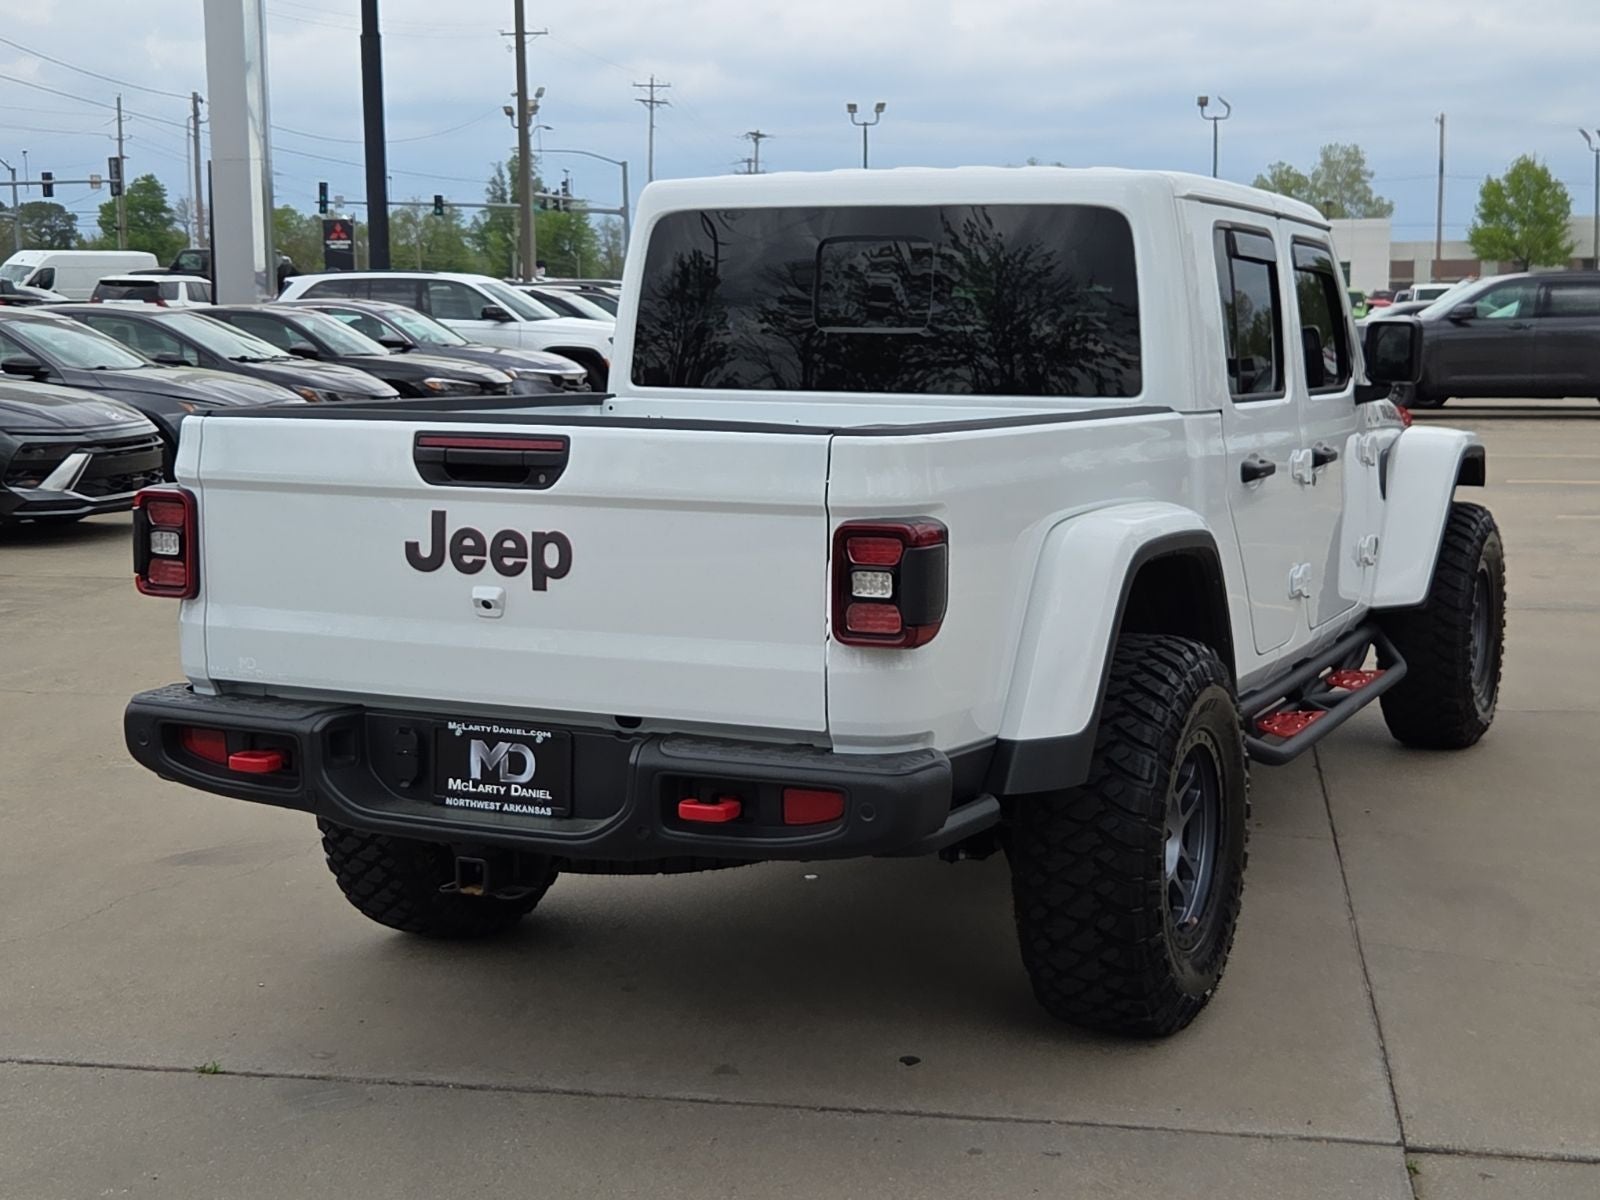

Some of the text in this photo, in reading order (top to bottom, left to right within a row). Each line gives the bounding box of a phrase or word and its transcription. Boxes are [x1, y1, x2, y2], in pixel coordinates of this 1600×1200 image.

[405, 510, 572, 591] Jeep
[470, 739, 536, 783] MD
[445, 797, 552, 816] NORTHWEST ARKANSAS
[510, 784, 552, 799] DANIEL
